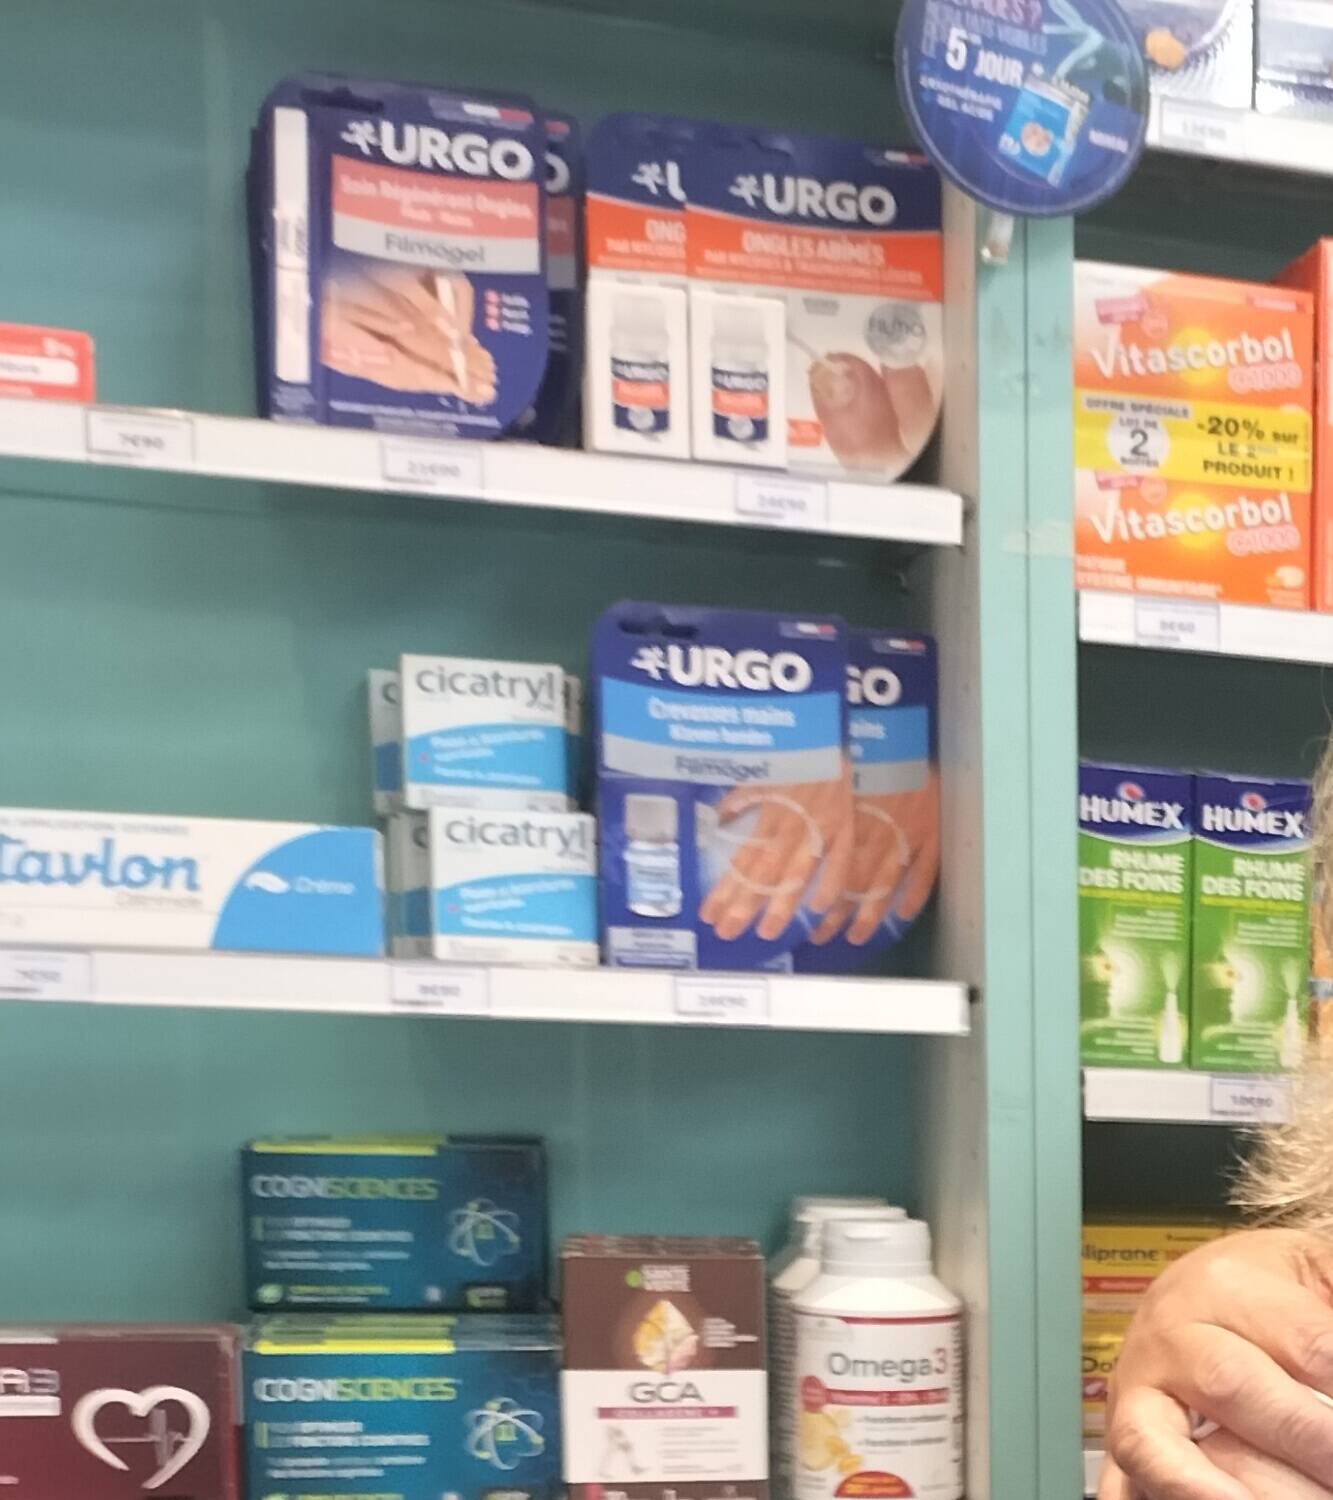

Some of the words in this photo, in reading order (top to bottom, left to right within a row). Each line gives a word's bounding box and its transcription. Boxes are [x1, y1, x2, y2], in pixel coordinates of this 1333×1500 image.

[381, 124, 534, 181] URGO
[756, 178, 898, 225] URGO
[1090, 326, 1295, 379] Vitascorbol
[1129, 429, 1151, 458] 2
[1198, 415, 1264, 440] -20%
[1203, 460, 1282, 480] PRODUIT
[1090, 491, 1292, 545] Vitascorbol
[667, 643, 811, 693] URGO
[415, 665, 556, 707] cicatryl
[1080, 794, 1185, 830] HUMEX
[1203, 804, 1307, 839] HUMEX
[445, 816, 588, 851] cicatryl
[1109, 849, 1185, 875] RHUME
[1233, 858, 1306, 882] RHUME
[1080, 867, 1119, 890] DES
[1122, 872, 1185, 894] FOINS
[1202, 875, 1240, 898] DES
[1244, 880, 1304, 902] FOINS
[254, 1376, 456, 1401] COGNISCIENCES
[629, 1381, 703, 1403] GCA
